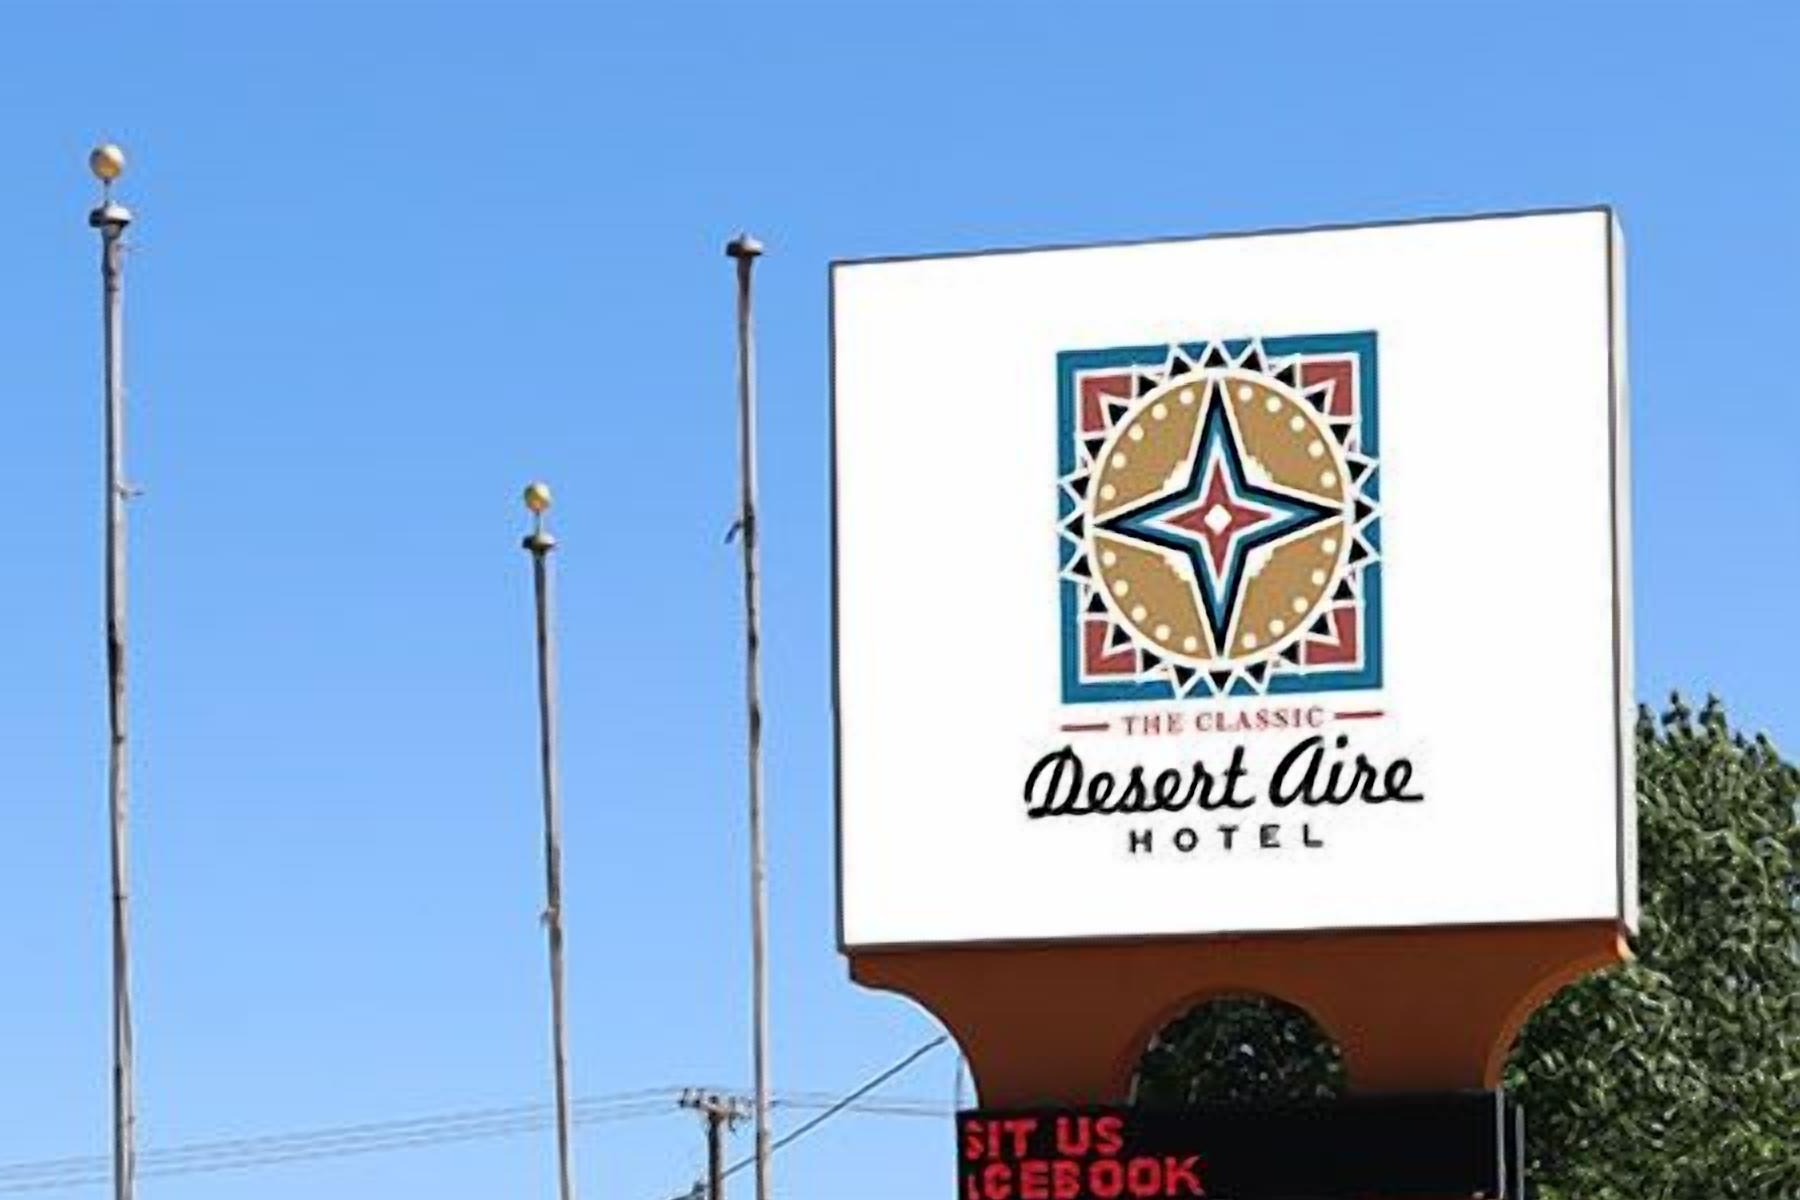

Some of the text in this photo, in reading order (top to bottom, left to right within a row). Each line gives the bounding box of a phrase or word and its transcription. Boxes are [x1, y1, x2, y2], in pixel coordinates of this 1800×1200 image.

[1120, 706, 1325, 736] THE CLASSIC
[1023, 734, 1425, 819] Desert Aire
[1128, 823, 1324, 853] HOTEL
[1055, 1116, 1125, 1155] US
